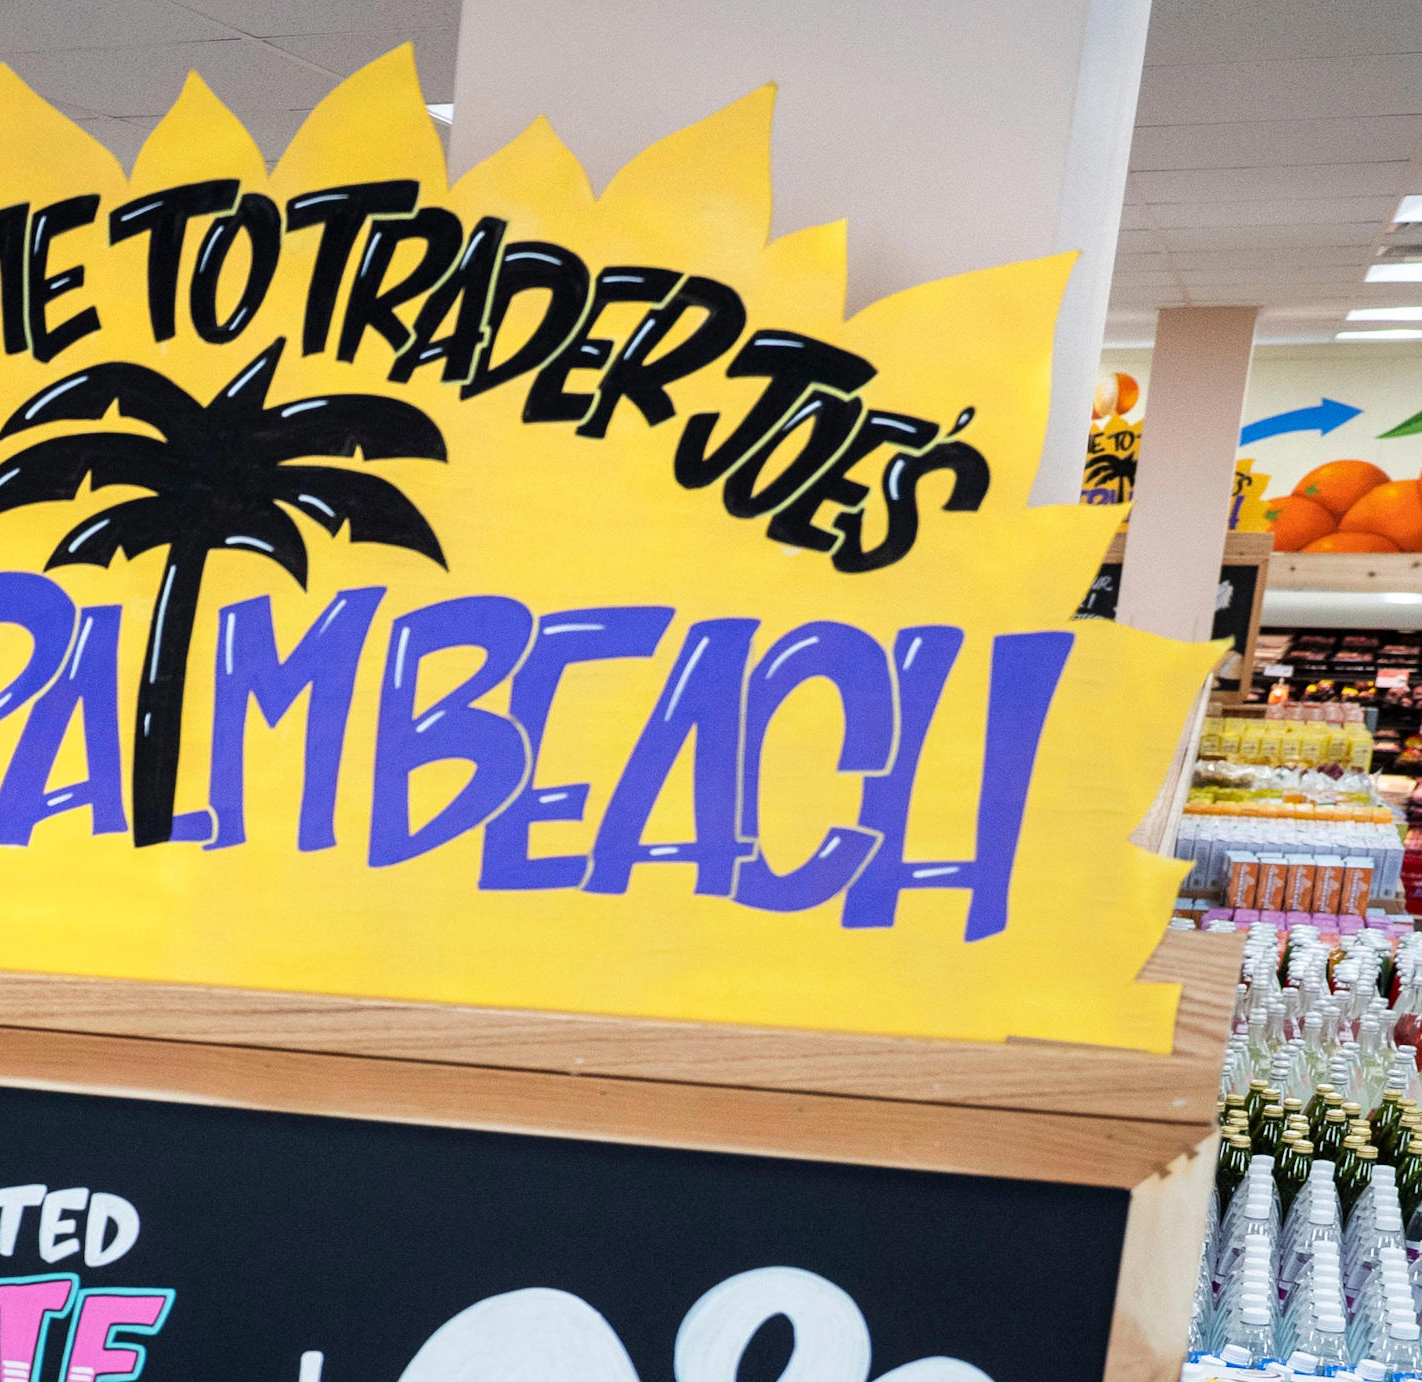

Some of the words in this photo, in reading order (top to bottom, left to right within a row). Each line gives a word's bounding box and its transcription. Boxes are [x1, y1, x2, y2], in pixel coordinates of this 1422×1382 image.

[108, 178, 282, 345] TO
[285, 179, 748, 440] TRADER
[673, 329, 991, 574] JOE'S
[368, 595, 1076, 942] BEACH
